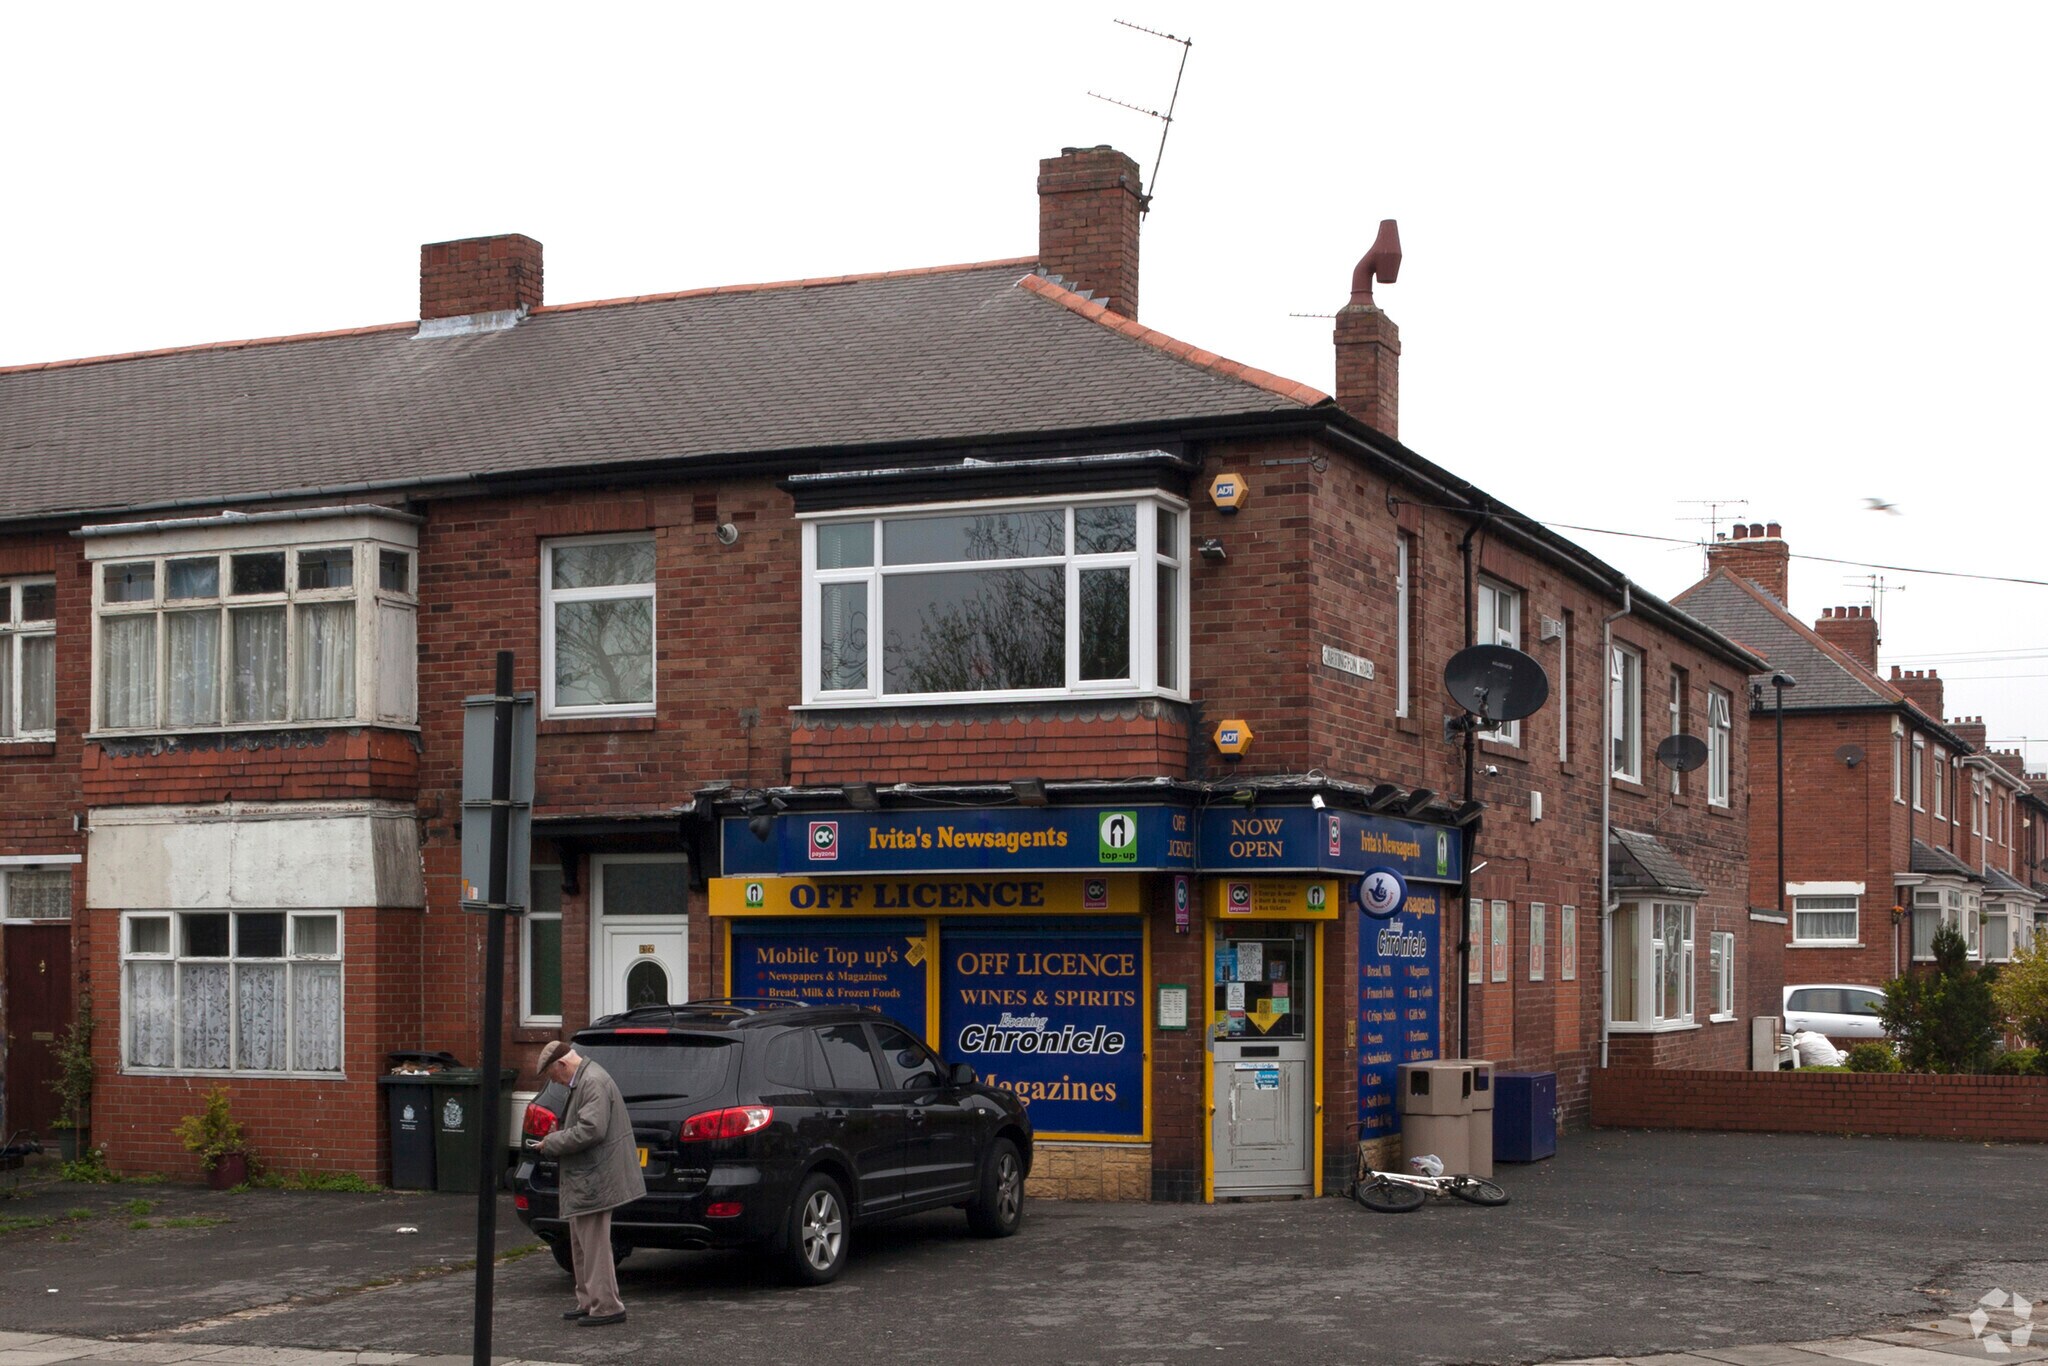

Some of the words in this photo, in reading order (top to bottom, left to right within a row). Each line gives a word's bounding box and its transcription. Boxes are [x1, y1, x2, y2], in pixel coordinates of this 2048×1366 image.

[1217, 485, 1234, 496] ADT
[1221, 732, 1237, 743] ADT
[1173, 815, 1185, 831] OFF
[1231, 819, 1283, 836] NOW
[869, 826, 932, 849] Ivita's
[937, 826, 1068, 853] Newsagents
[1361, 830, 1381, 854] Ivita's
[1382, 833, 1421, 861] Newsagents
[1101, 851, 1135, 861] top-up
[1167, 840, 1193, 857] ICENC
[1229, 841, 1284, 857] OPEN
[790, 884, 863, 908] OFF
[873, 882, 1045, 908] LICENCE
[1403, 894, 1436, 920] wsagents
[1377, 928, 1427, 957] Chronicle
[756, 947, 819, 964] Mobile
[824, 947, 858, 968] Top
[864, 946, 898, 968] up's
[957, 953, 1009, 975] OFF
[1016, 953, 1135, 977] LICENCE
[769, 971, 823, 982] Newspapers
[826, 971, 834, 981] &
[838, 971, 888, 982] Magazines
[769, 988, 799, 998] Bread,
[802, 988, 823, 997] Milk
[826, 988, 834, 998] &
[838, 988, 870, 997] Frozen
[873, 988, 901, 998] Foods
[960, 990, 1027, 1005] WINES
[1032, 990, 1049, 1005] &
[1054, 990, 1135, 1006] SPIRITS
[1409, 987, 1421, 1000] Fany
[998, 1012, 1048, 1032] Evening
[959, 1024, 1125, 1054] Chronicle
